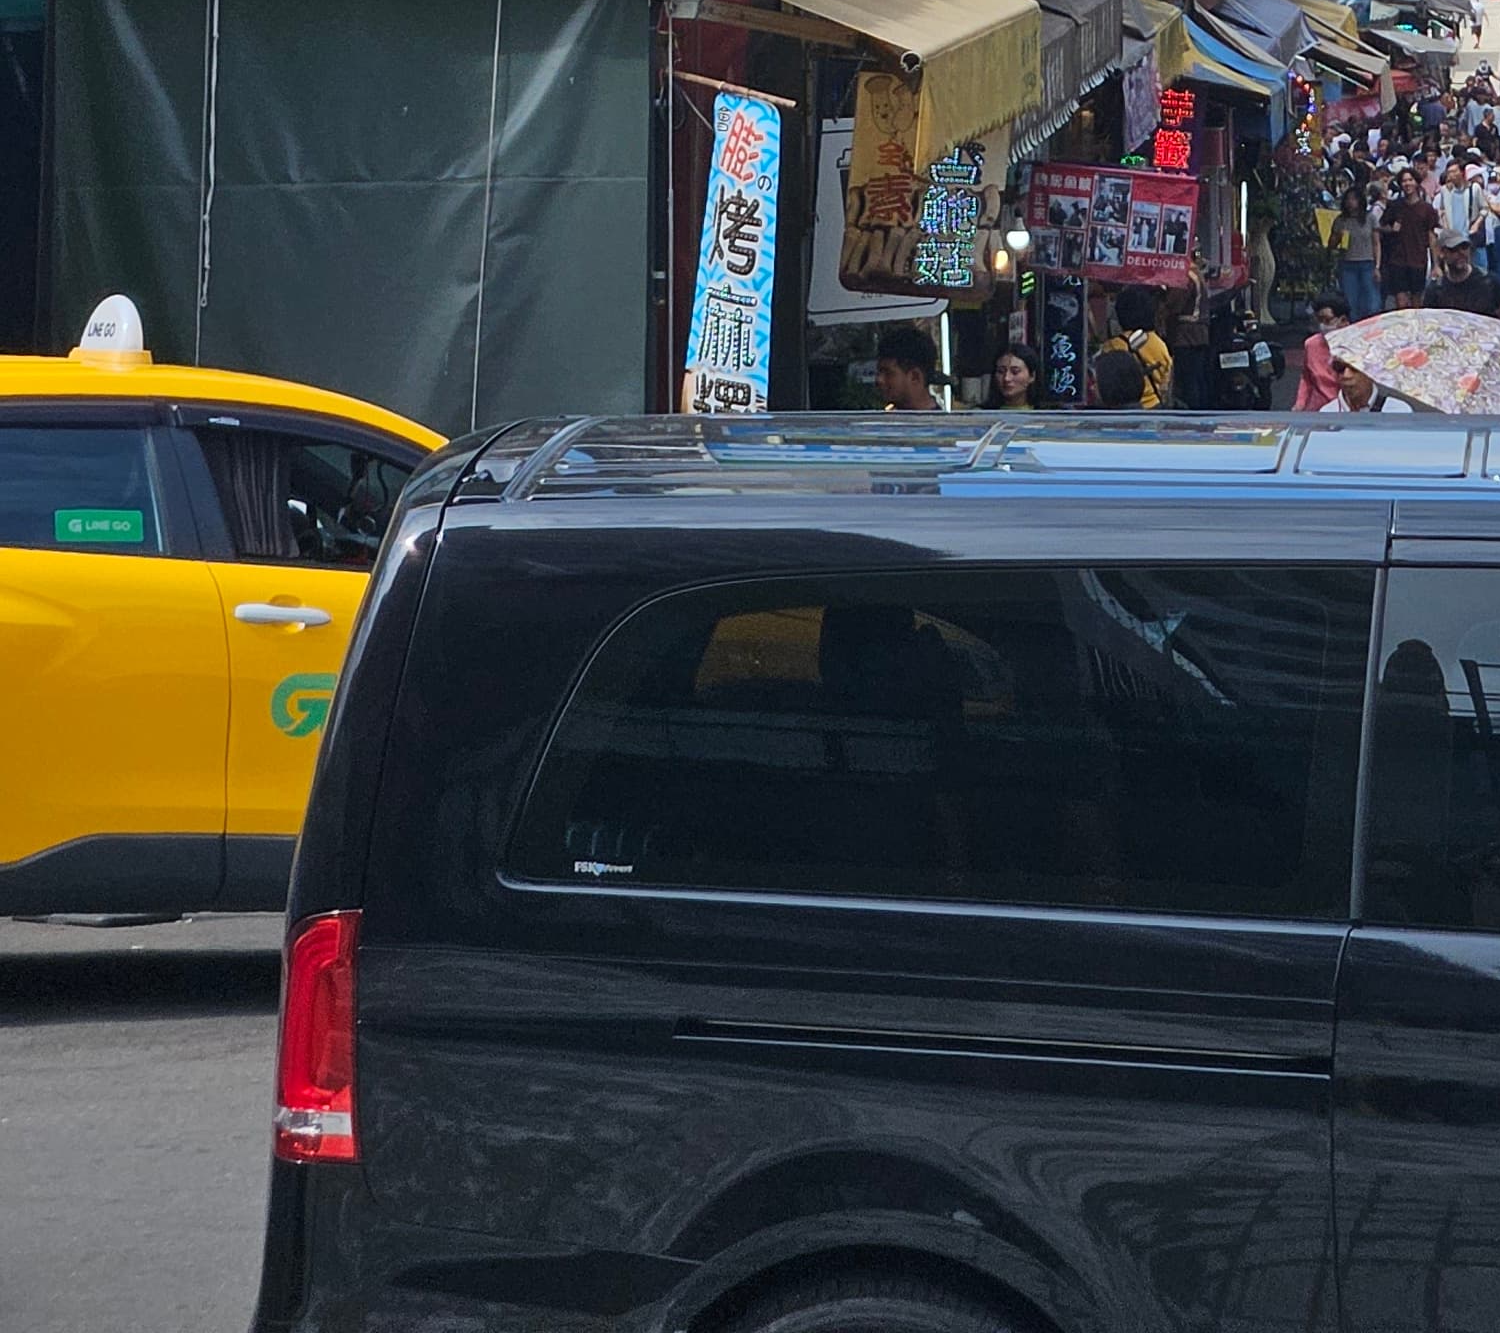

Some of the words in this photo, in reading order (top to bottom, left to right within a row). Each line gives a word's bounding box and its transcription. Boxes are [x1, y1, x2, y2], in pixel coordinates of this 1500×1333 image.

[1127, 255, 1186, 271] DELICIOUS
[104, 322, 116, 337] GO
[111, 521, 131, 532] GO
